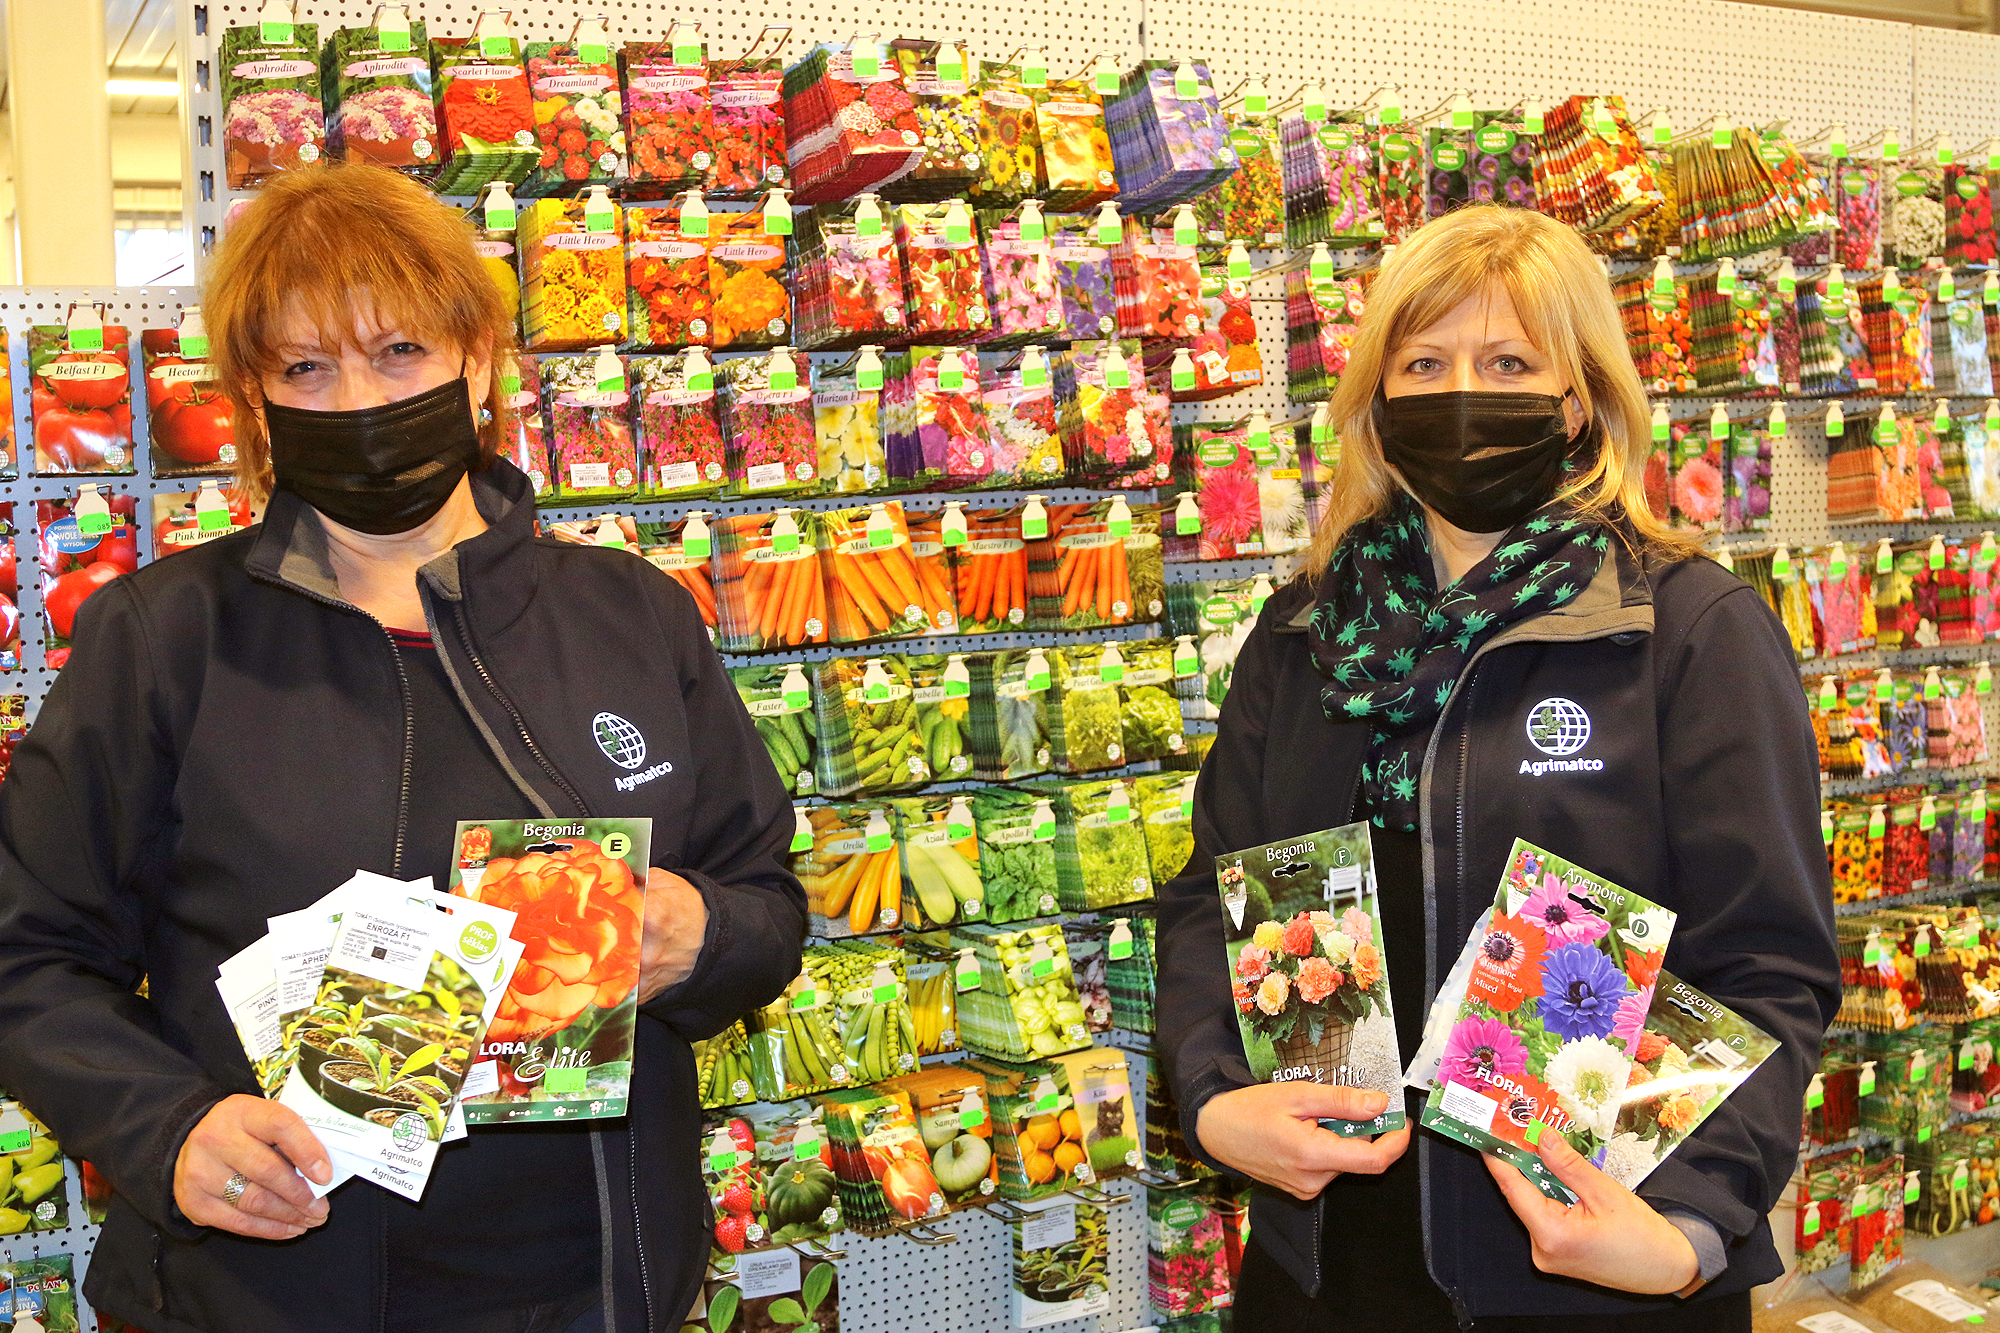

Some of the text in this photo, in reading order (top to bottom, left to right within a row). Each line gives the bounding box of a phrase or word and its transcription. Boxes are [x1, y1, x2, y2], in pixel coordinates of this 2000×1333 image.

[250, 63, 298, 75] Aphrodite
[361, 61, 408, 74] Aphrodite
[452, 67, 513, 76] Scarlet Flame
[548, 77, 598, 88] Dreamland
[644, 77, 694, 90] Super Elfin
[721, 94, 747, 104] Super
[558, 235, 606, 246] Little Hero
[1009, 242, 1029, 251] Royal
[657, 243, 682, 255] Safari
[724, 247, 768, 257] Little Hero
[1069, 249, 1089, 259] Royal
[1157, 246, 1177, 256] Royal
[56, 365, 106, 377] Belfast F1
[168, 367, 200, 377] Hector
[817, 391, 861, 404] Horizon F1
[174, 530, 195, 541] Pink
[1072, 534, 1107, 547] Tempo F1
[972, 540, 1013, 551] Maestro F1
[654, 555, 682, 566] Nantes
[1073, 677, 1090, 688] Pearl
[1131, 672, 1156, 682] Nadine
[756, 702, 782, 711] Faster
[1519, 758, 1605, 777] Agrimatco
[614, 761, 673, 792] Agrimatco
[523, 822, 585, 841] Begonia
[924, 832, 945, 843] Aziad
[999, 829, 1024, 841] Apollo
[609, 839, 623, 852] E
[843, 840, 864, 850] Orelia
[1266, 839, 1316, 863] Begonia
[1338, 850, 1346, 863] F
[1562, 868, 1626, 906] Anemone
[366, 922, 411, 941] ENROZA F1
[468, 924, 495, 942] PROF
[1634, 920, 1648, 936] D
[462, 933, 489, 954] sēklas
[1483, 958, 1517, 980] Anemone
[1473, 976, 1498, 994] Mixed
[257, 996, 277, 1011] PINK
[1238, 994, 1258, 1006] Mixed
[1468, 993, 1480, 1005] 20
[1672, 982, 1725, 1021] Begonia
[1730, 1036, 1744, 1047] F
[479, 1041, 527, 1056] LORA
[514, 1046, 592, 1083] Elite
[1272, 1065, 1312, 1083] FLORA
[1475, 1066, 1525, 1099] FLORA
[1509, 1096, 1577, 1134] Elite
[380, 1148, 423, 1168] Agrimatco
[371, 1167, 414, 1191] Agrimatco
[27, 1280, 61, 1293] POLAN
